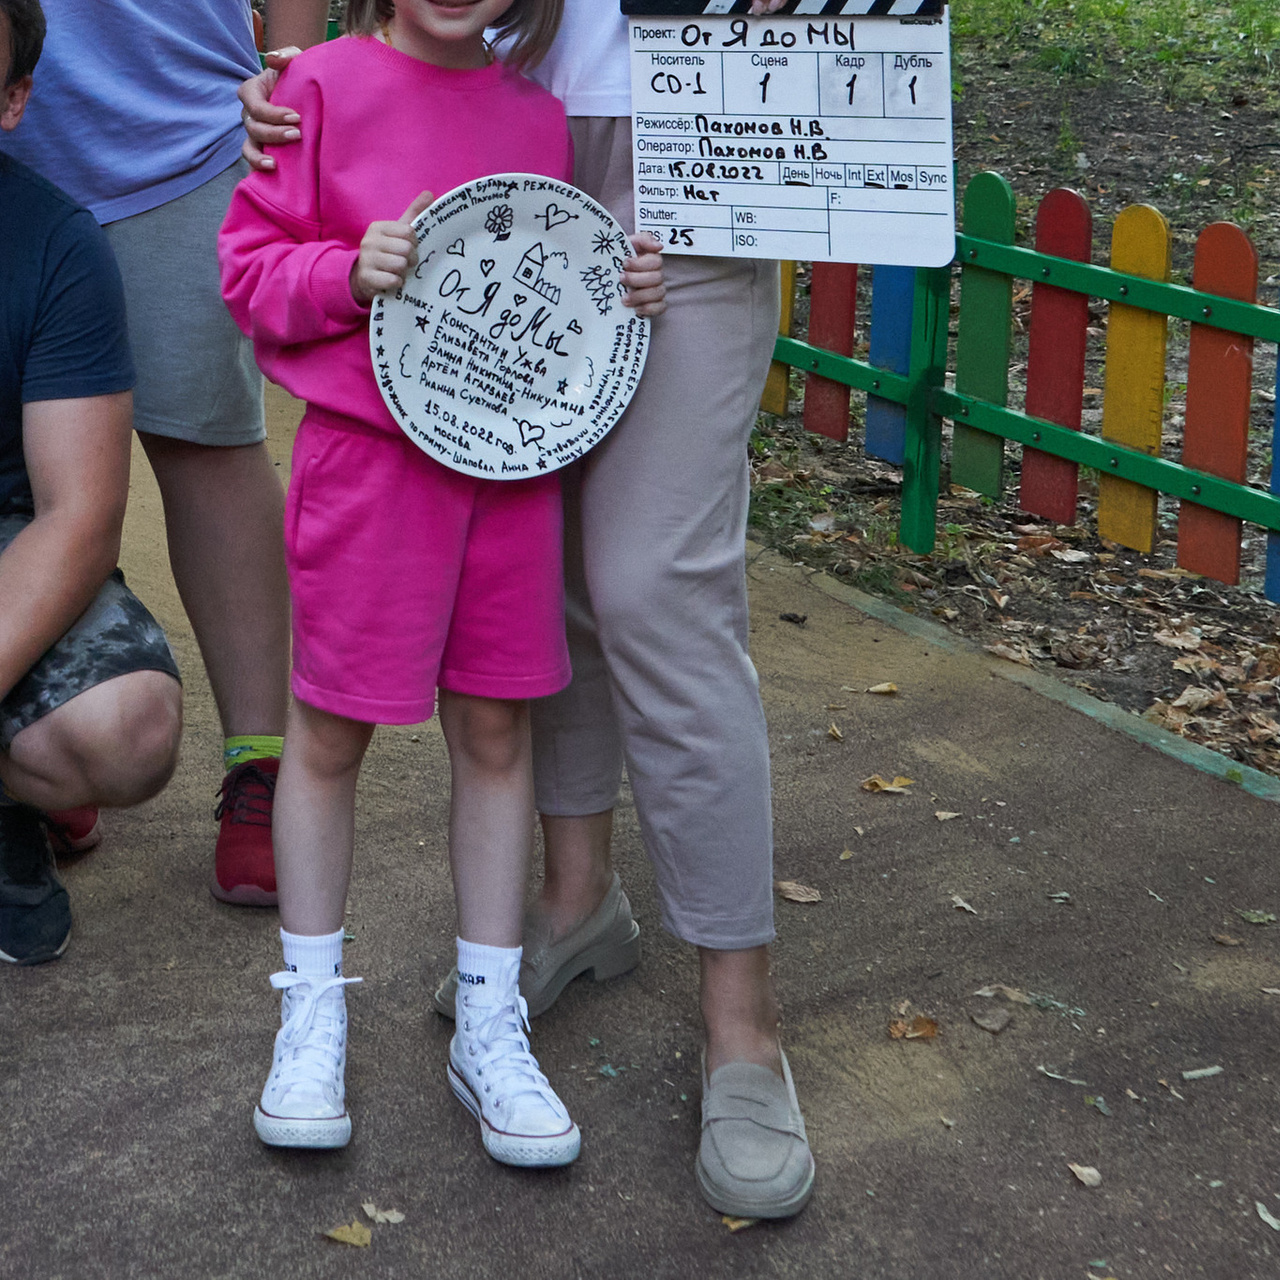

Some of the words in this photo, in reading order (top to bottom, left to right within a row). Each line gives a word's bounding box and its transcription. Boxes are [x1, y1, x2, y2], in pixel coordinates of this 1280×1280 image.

[633, 26, 676, 41] Проект:
[681, 24, 712, 47] От
[722, 19, 749, 47] Я
[807, 22, 855, 51] МЫ
[651, 53, 705, 66] Носитель
[751, 54, 788, 68] Сцена
[835, 54, 866, 69] Кадр
[894, 55, 933, 70] Дубль
[759, 72, 771, 104] 1
[846, 73, 857, 105] 1
[908, 75, 917, 105] 1
[636, 117, 694, 132] Режиссёр:
[695, 114, 784, 136] Пахомов
[637, 139, 695, 154] Оператор:
[698, 137, 786, 160] Пахомов
[638, 162, 666, 176] Дата:
[668, 161, 764, 180] 15.08.2022
[782, 167, 810, 180] День
[815, 168, 843, 180] Ночь
[848, 169, 861, 181] Int
[867, 169, 885, 181] Ext
[891, 170, 914, 182] Mos
[920, 171, 947, 186] Sync
[638, 185, 678, 199] Фильтр:
[683, 184, 720, 203] Нет
[831, 193, 841, 205] F:
[639, 208, 677, 220] Shutter:
[735, 212, 757, 224] WB:
[669, 228, 694, 246] 25
[735, 234, 758, 247] ISO:
[439, 269, 471, 302] От
[457, 281, 501, 317] Я
[490, 309, 522, 339] до
[511, 306, 569, 357] Мы
